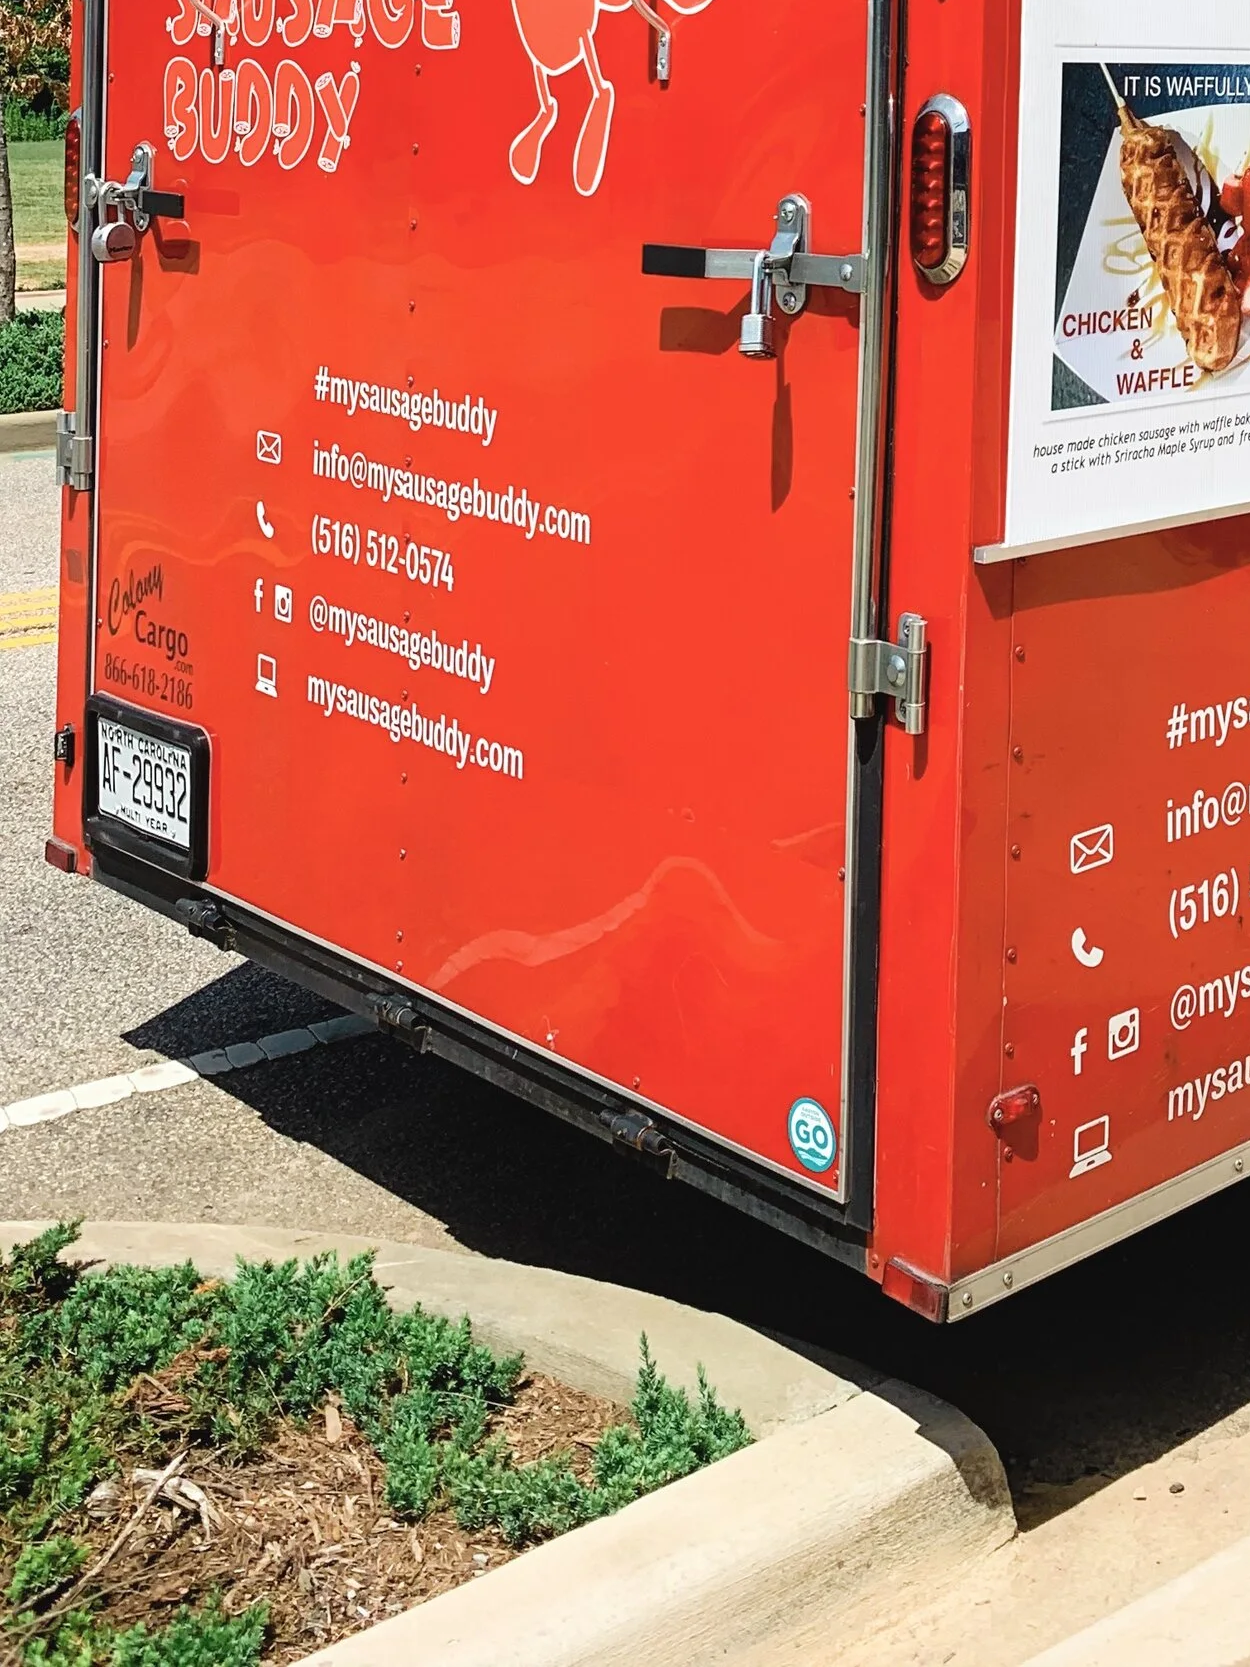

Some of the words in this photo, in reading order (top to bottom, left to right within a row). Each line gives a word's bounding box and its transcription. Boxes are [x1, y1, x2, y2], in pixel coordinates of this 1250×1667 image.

[1124, 76, 1140, 96] IT
[1145, 76, 1161, 97] IS
[163, 56, 361, 174] BUDDY
[1063, 307, 1153, 337] CHICKEN
[1131, 338, 1143, 360] &
[1116, 365, 1194, 395] WAFFLE
[314, 365, 498, 447] #mysausagebuddy
[1032, 442, 1064, 458] house
[1066, 438, 1096, 453] made
[1098, 431, 1136, 449] chicken
[1138, 426, 1176, 443] sausage
[1178, 420, 1200, 436] with
[1202, 416, 1232, 433] waffle
[1051, 462, 1058, 473] a
[1060, 455, 1086, 472] stick
[1088, 451, 1112, 467] with
[1114, 446, 1155, 464] Sriracha
[1157, 440, 1187, 458] Maple
[1189, 435, 1215, 452] Syrup
[1217, 432, 1235, 447] and
[312, 440, 592, 545] info@mysausagebuddy.com
[311, 514, 361, 565] (516)
[366, 529, 455, 592] 512-0574
[108, 563, 165, 636] Colony
[134, 609, 188, 660] Cargo
[309, 595, 496, 695] @mysausagebuddy
[104, 652, 194, 710] 866-618-2186
[174, 658, 194, 676] .com
[101, 721, 135, 750] NORTH
[137, 738, 188, 771] CAROLINA
[307, 673, 524, 780] mysausagebuddy.com
[102, 742, 188, 825] AF-29932
[120, 804, 142, 825] MULTI
[145, 815, 169, 834] YEAR
[1168, 868, 1240, 939] (516)
[796, 1119, 828, 1150] GO
